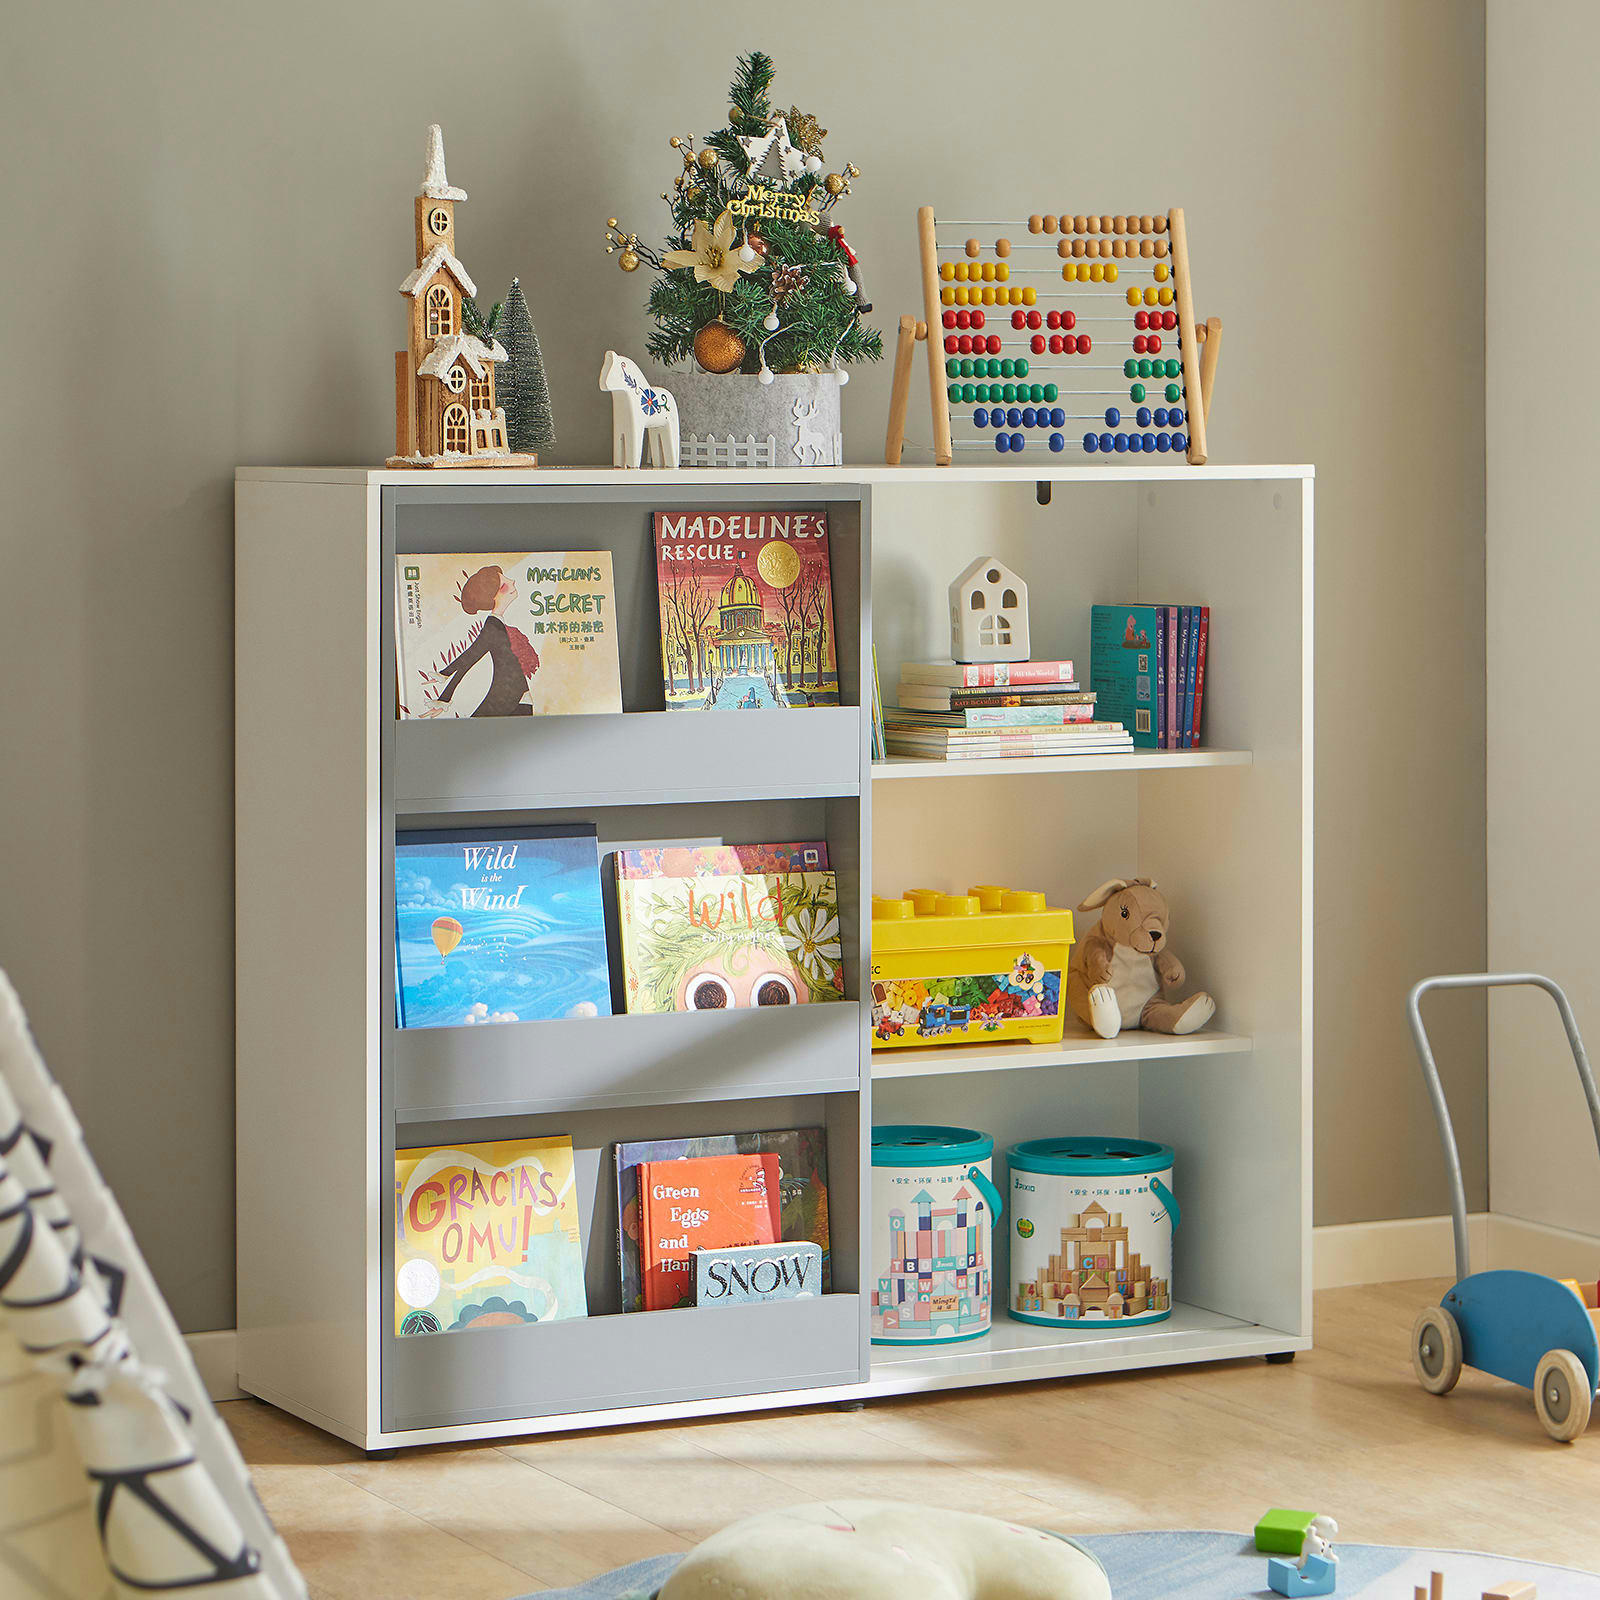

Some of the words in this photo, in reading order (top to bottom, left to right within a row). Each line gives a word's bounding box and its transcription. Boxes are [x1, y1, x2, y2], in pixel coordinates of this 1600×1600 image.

[744, 184, 806, 211] Merry
[726, 199, 820, 226] Christmas
[661, 544, 734, 561] RESCUE
[526, 566, 602, 584] MAGICIAN'S
[529, 590, 606, 617] SECRET
[534, 620, 604, 634] 魔术师的秘密
[463, 844, 519, 871] Wild
[481, 874, 488, 882] is
[490, 873, 502, 882] the
[460, 885, 529, 911] Wind
[653, 1185, 700, 1200] Green
[670, 1207, 710, 1228] Eggs
[442, 1205, 533, 1263] OMU!
[659, 1235, 689, 1249] and
[906, 1261, 916, 1272] B
[968, 1255, 975, 1266] P
[1083, 1257, 1094, 1270] C
[705, 1253, 816, 1298] SNOW
[1117, 1269, 1127, 1281] U
[880, 1280, 889, 1290] V
[1065, 1306, 1078, 1319] M
[1111, 1306, 1121, 1319] T
